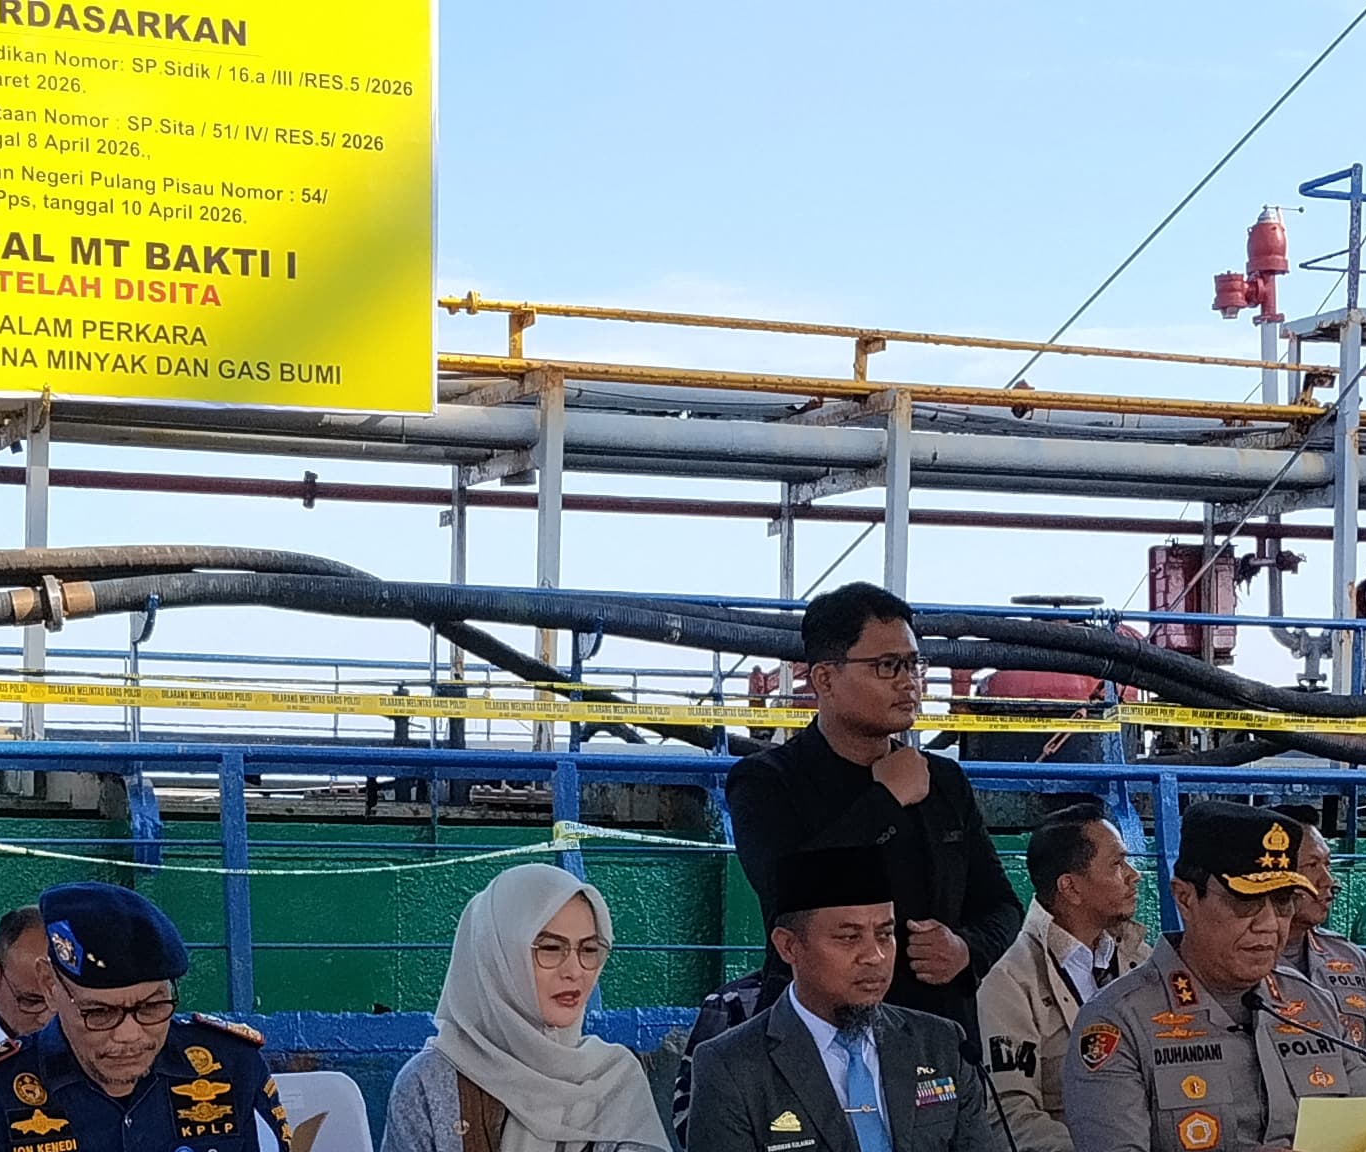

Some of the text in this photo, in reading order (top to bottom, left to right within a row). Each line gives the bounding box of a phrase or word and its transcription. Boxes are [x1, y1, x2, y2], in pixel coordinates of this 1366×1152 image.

[37, 75, 85, 93] 2026.
[133, 58, 209, 78] SP.Sidik
[230, 67, 265, 84] 16.a
[270, 69, 291, 86] /III
[299, 72, 359, 93] /RES.5
[364, 78, 412, 96] /2026
[45, 109, 108, 128] Nomor
[128, 116, 194, 136] SP.Sita
[213, 124, 238, 139] 51/
[246, 126, 268, 141] IV/
[276, 128, 335, 147] RES.5/
[343, 134, 383, 150] 2026
[28, 133, 37, 148] 8
[45, 135, 89, 154] April
[22, 166, 83, 187] Negeri
[91, 172, 155, 195] Pulang
[163, 178, 213, 195] Pisau
[222, 182, 283, 200] Nomor
[302, 188, 327, 204] 54/
[43, 195, 113, 216] tanggal
[122, 200, 141, 215] 10
[149, 202, 192, 221] April
[200, 206, 246, 223] 2026.
[71, 236, 129, 267] MT
[146, 242, 269, 277] BAKTI
[115, 279, 221, 306] DISITA
[83, 320, 207, 346] PERKARA
[48, 350, 147, 374] MINYAK
[157, 356, 208, 377] DAN
[219, 360, 270, 380] GAS
[281, 363, 340, 384] BUMI
[10, 683, 27, 693] POLISI
[1328, 975, 1366, 987] POLRI
[1154, 1044, 1223, 1065] DJUHANDANI
[1278, 1040, 1336, 1057] POLRI
